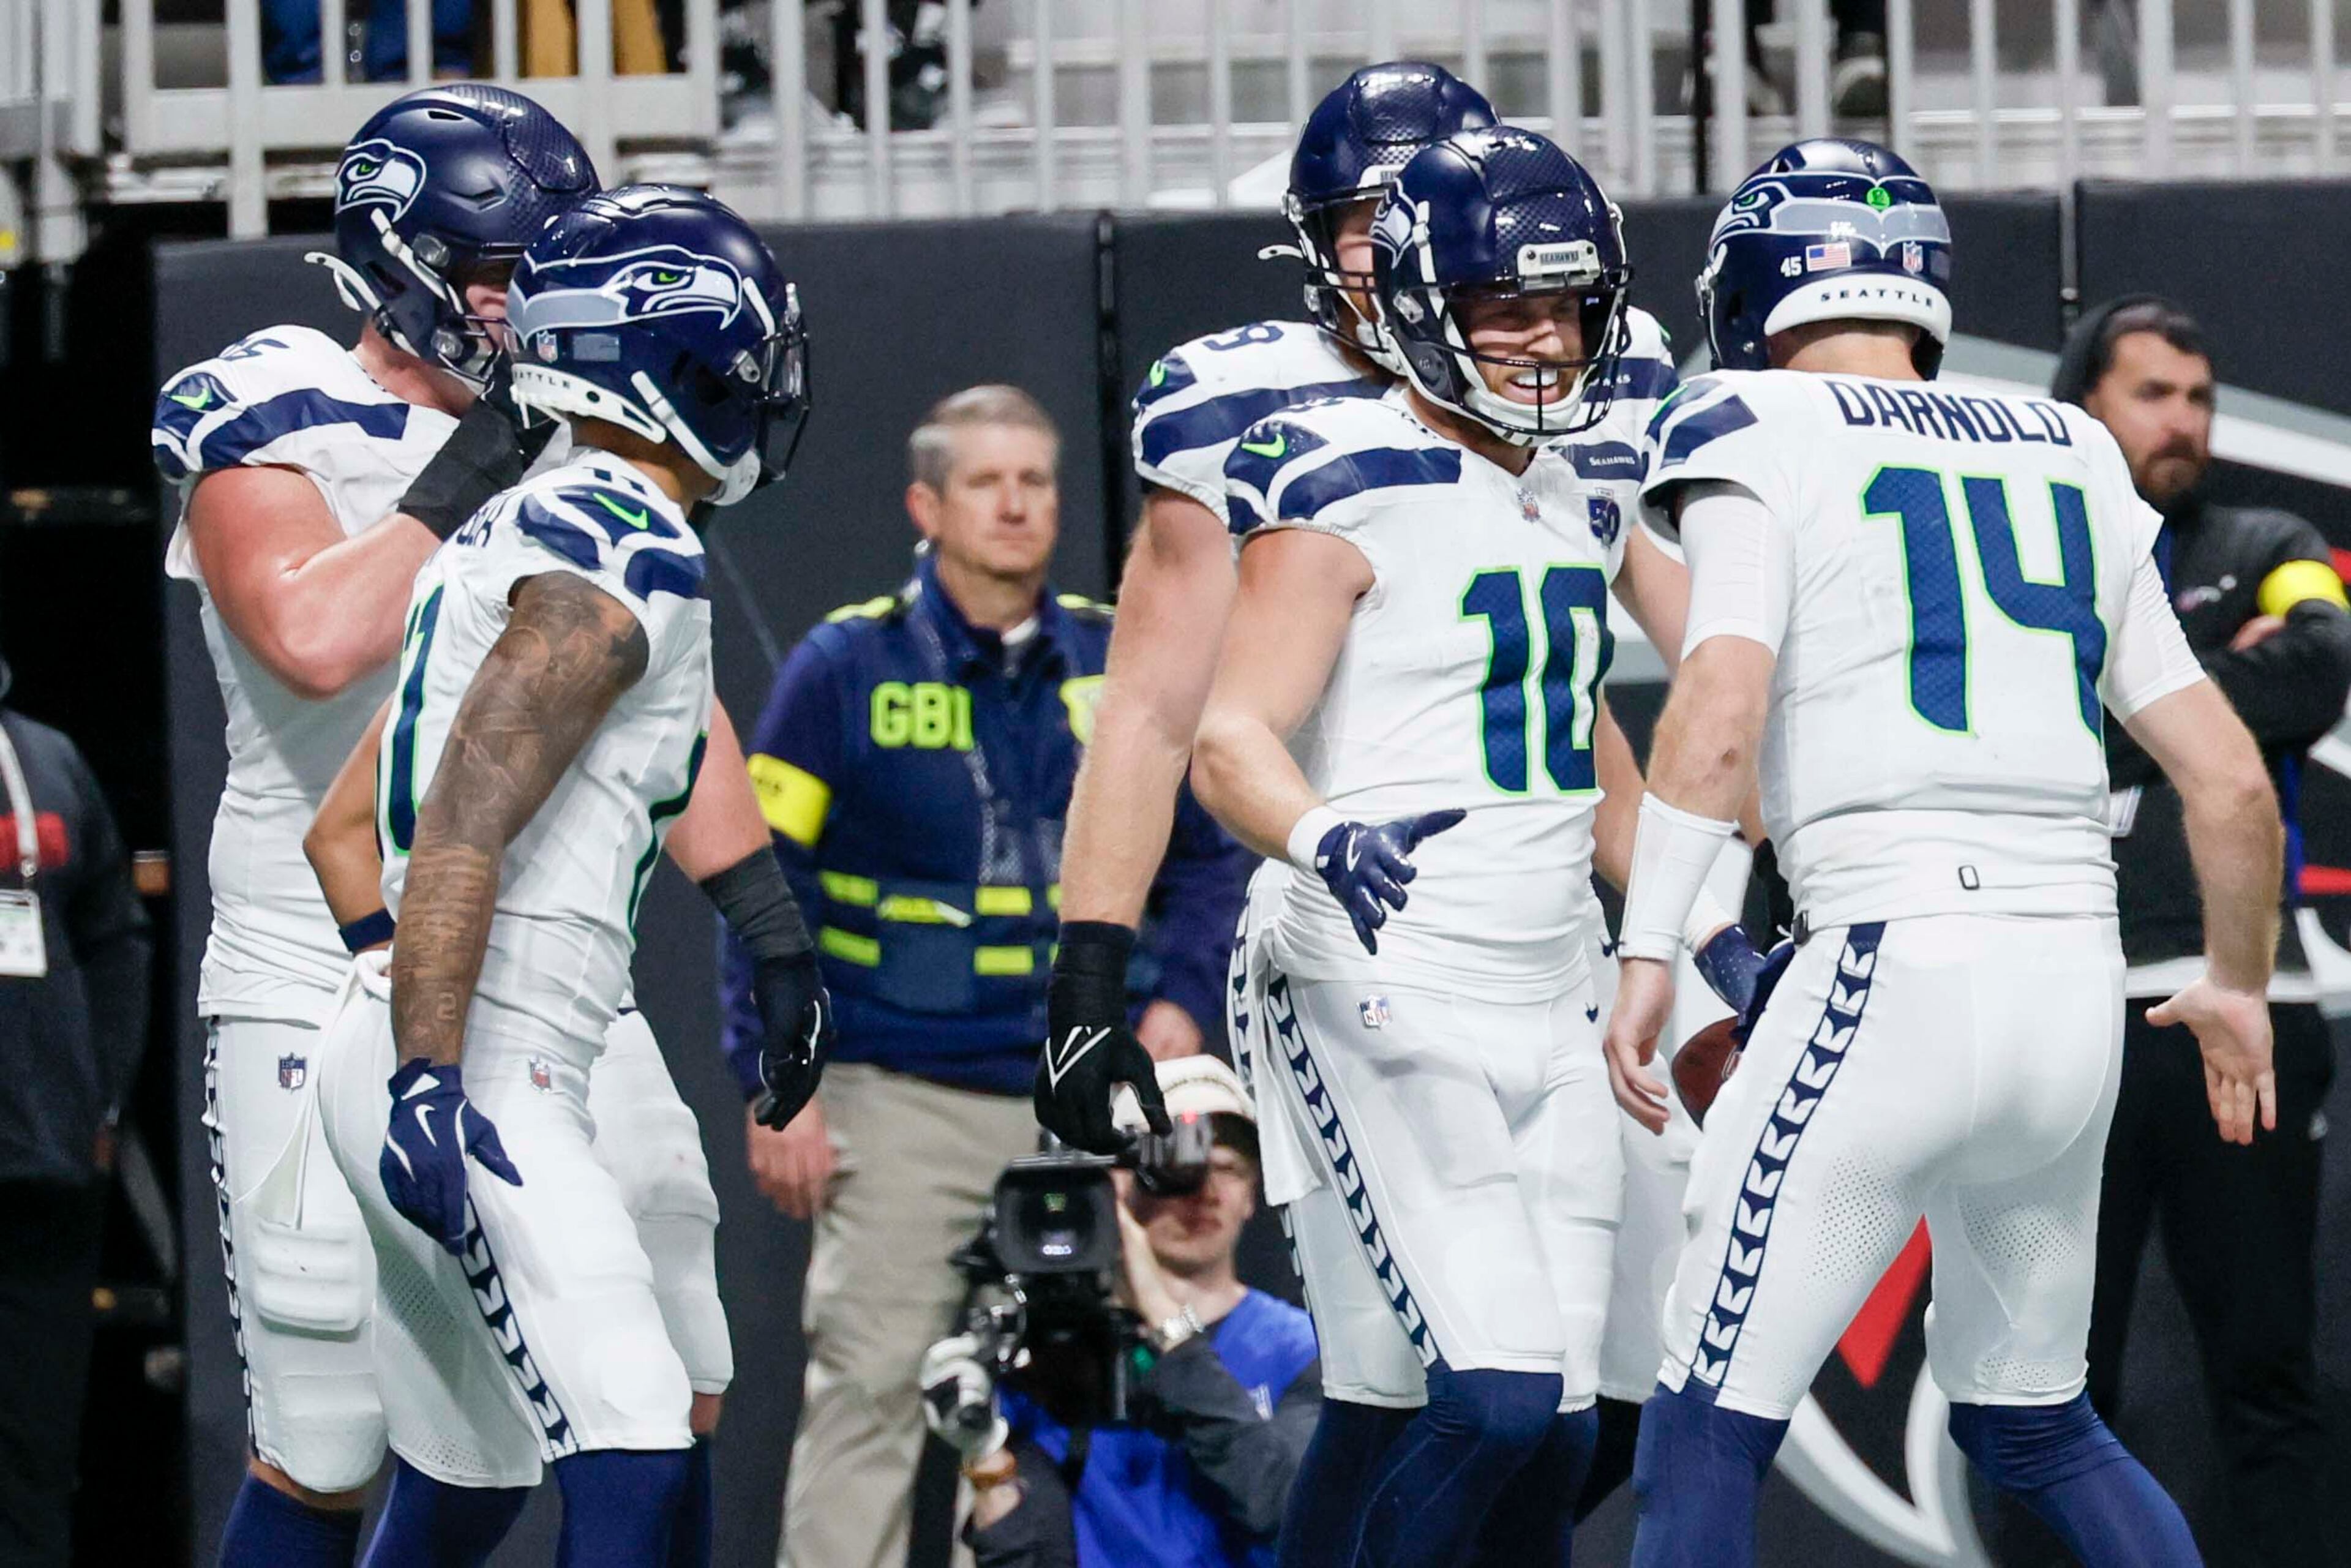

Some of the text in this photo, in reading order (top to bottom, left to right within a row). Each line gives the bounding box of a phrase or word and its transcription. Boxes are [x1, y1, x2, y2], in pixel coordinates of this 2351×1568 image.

[1780, 256, 1802, 277] 45
[1821, 289, 1932, 307] SEATTLE
[1824, 380, 2072, 446] DARNOLD
[1859, 462, 2109, 747] 14
[1457, 563, 1615, 797] 10
[870, 680, 974, 751] GBI
